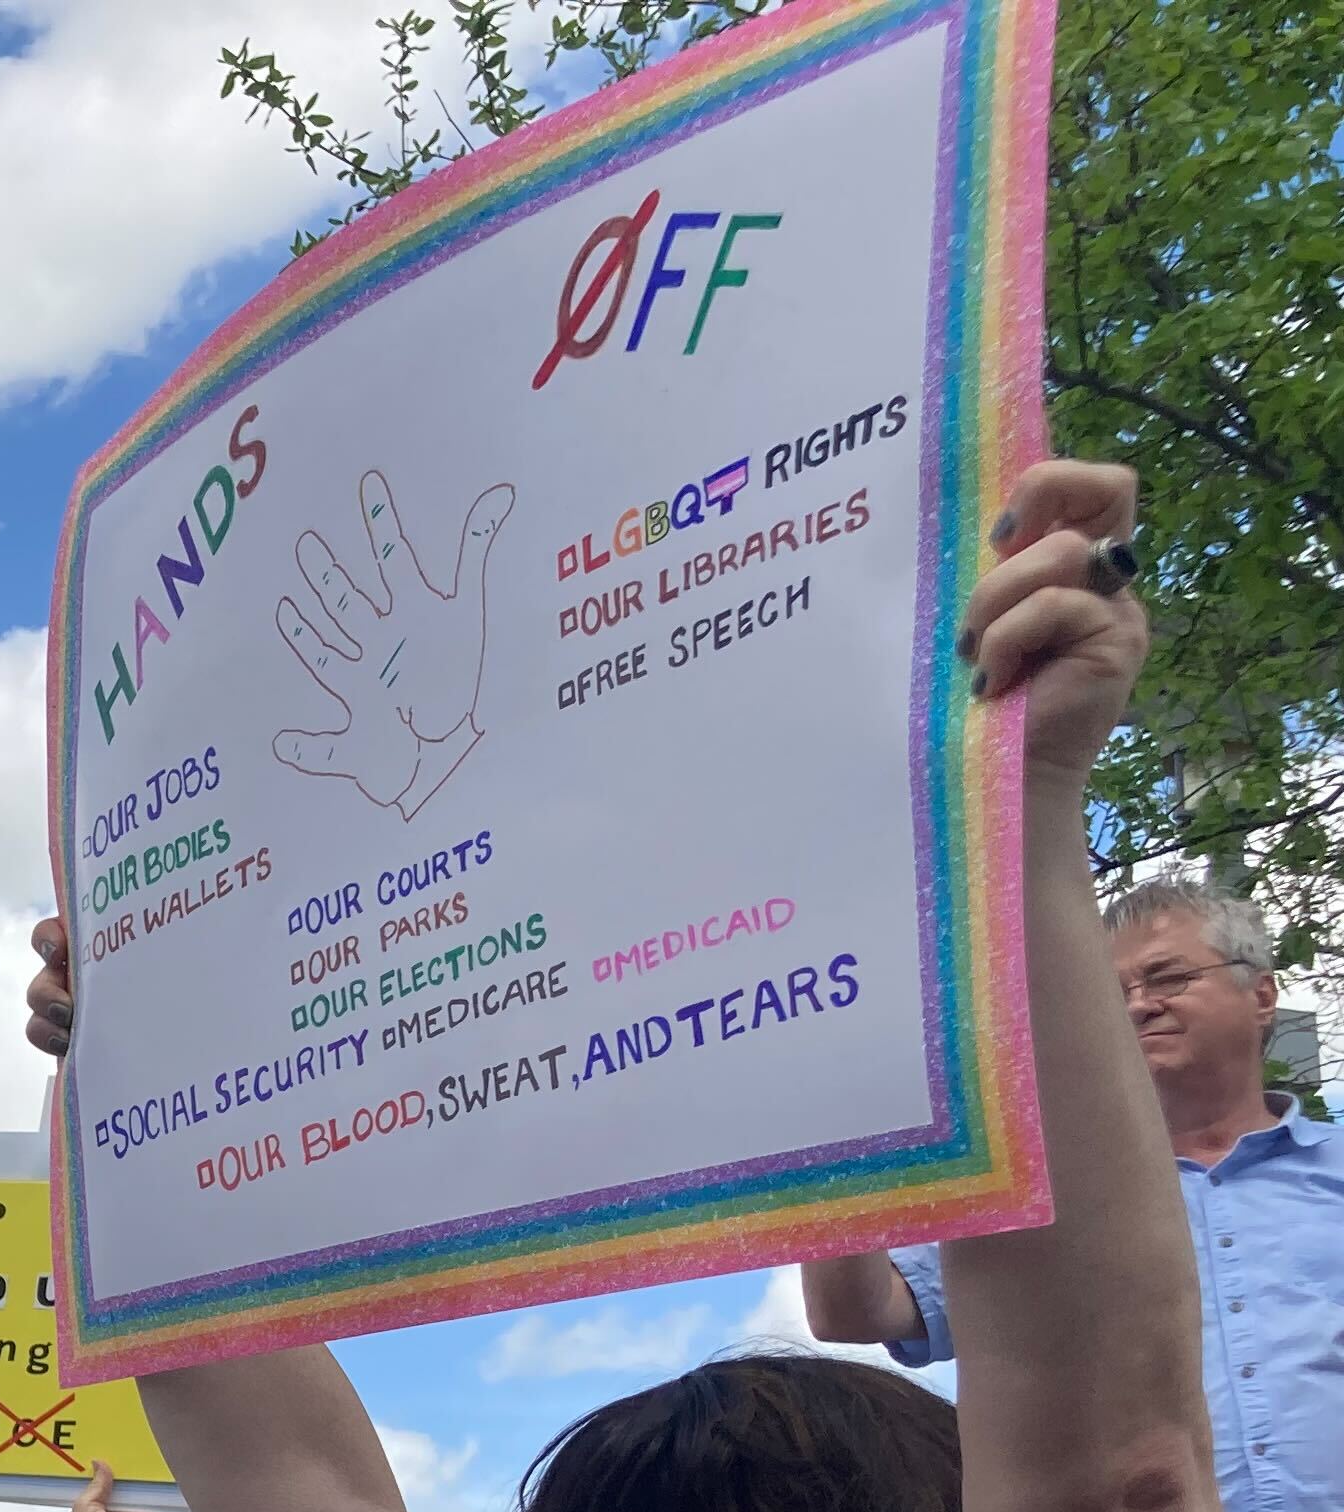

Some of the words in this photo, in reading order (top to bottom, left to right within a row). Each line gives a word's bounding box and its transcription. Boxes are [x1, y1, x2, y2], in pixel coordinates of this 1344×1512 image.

[538, 192, 784, 384] OFF
[764, 395, 908, 489] RIGHTS
[94, 404, 267, 745] HANDS
[580, 580, 644, 637] OUR
[658, 487, 871, 604] LIBRARIES
[577, 644, 648, 706] FREE
[668, 575, 811, 668] SPEECH
[92, 792, 140, 858] OUR
[146, 746, 221, 821] JOBS
[91, 913, 137, 962] OUR
[143, 847, 273, 935] WALLETS
[92, 854, 140, 916] OUR
[144, 817, 232, 886] BODIES
[304, 881, 364, 935] OUR
[376, 830, 494, 906] COURTS
[308, 934, 361, 985] OUR
[379, 891, 470, 953] PARKS
[308, 978, 368, 1028] OUR
[379, 912, 548, 1008] ELECTIONS
[111, 1083, 208, 1159] SOCIAL
[214, 1028, 369, 1114] SECURITY
[398, 960, 570, 1051] MEDICARE
[614, 897, 796, 983] MEDICAID
[217, 1132, 287, 1192] OUR
